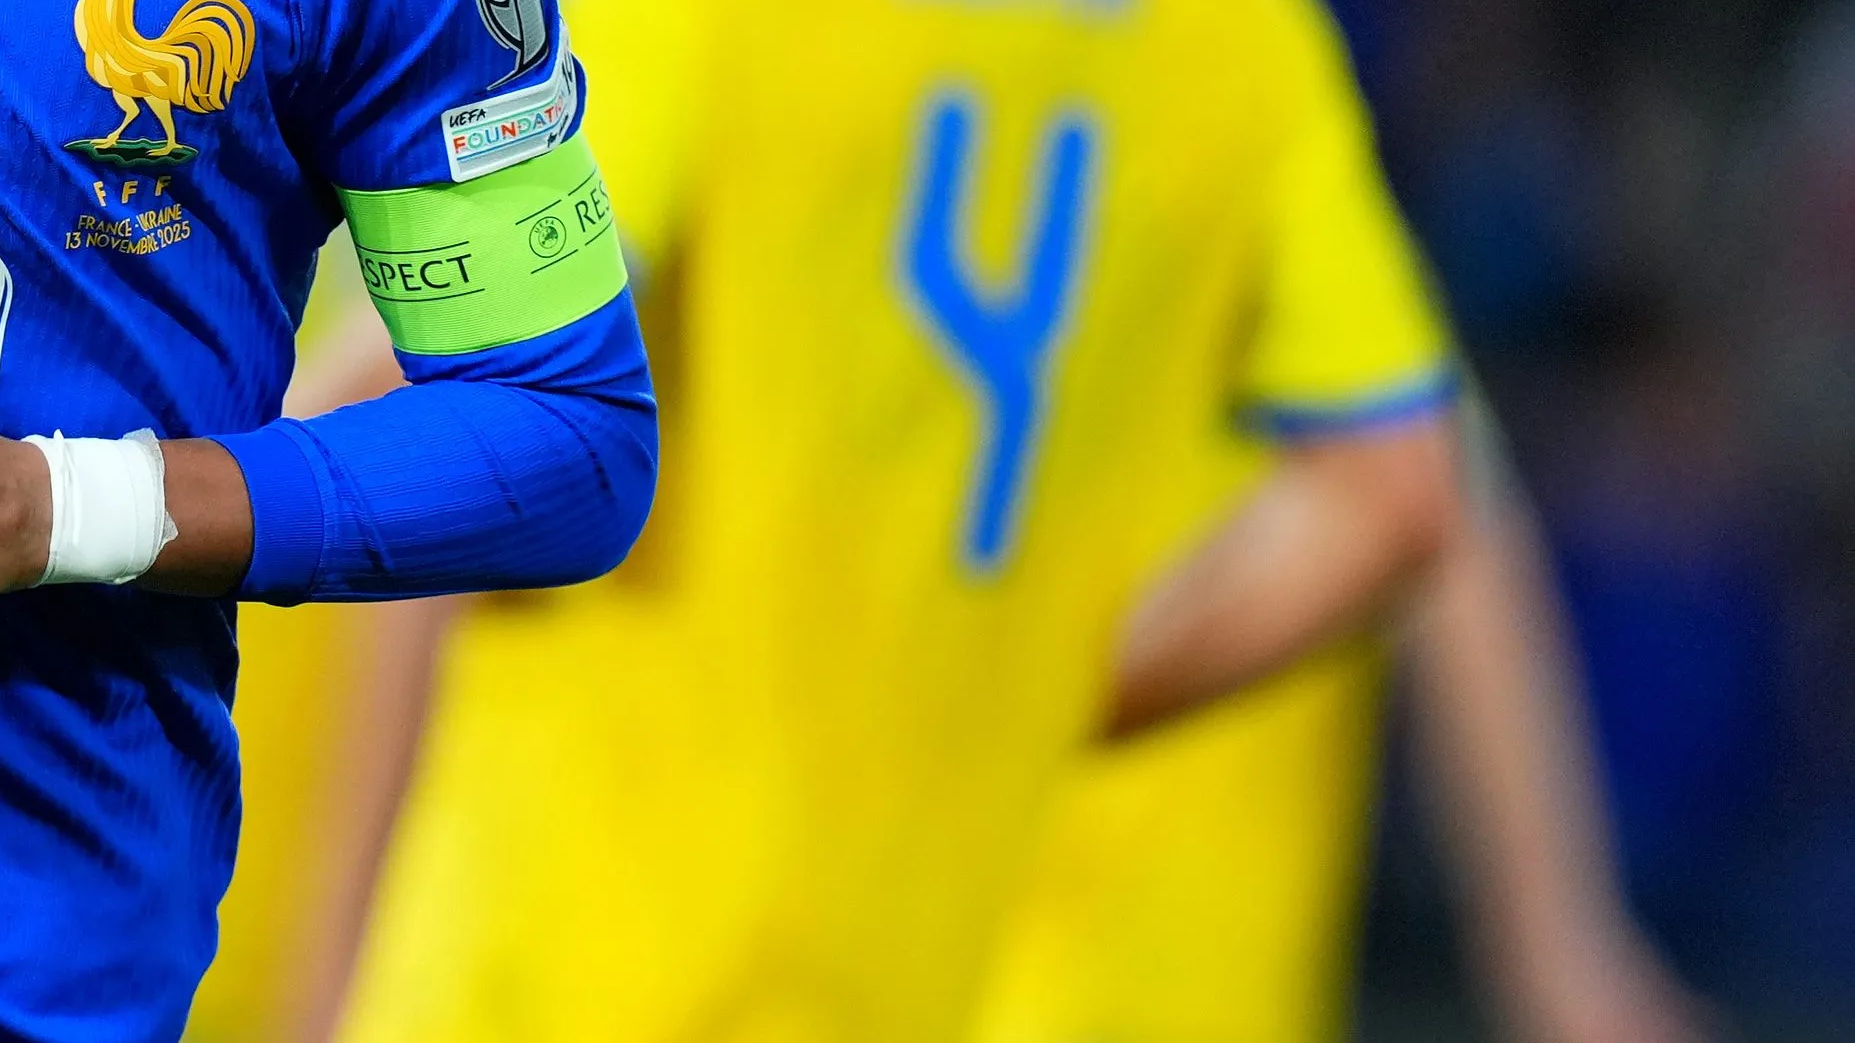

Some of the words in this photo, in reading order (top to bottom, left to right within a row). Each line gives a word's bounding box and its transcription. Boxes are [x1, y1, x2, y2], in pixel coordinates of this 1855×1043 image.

[449, 108, 486, 128] UEFA
[65, 231, 82, 250] 13
[85, 232, 160, 255] NOVEMBRE
[157, 220, 191, 249] 2025
[362, 253, 472, 292] SPECT
[902, 87, 1096, 570] 4
